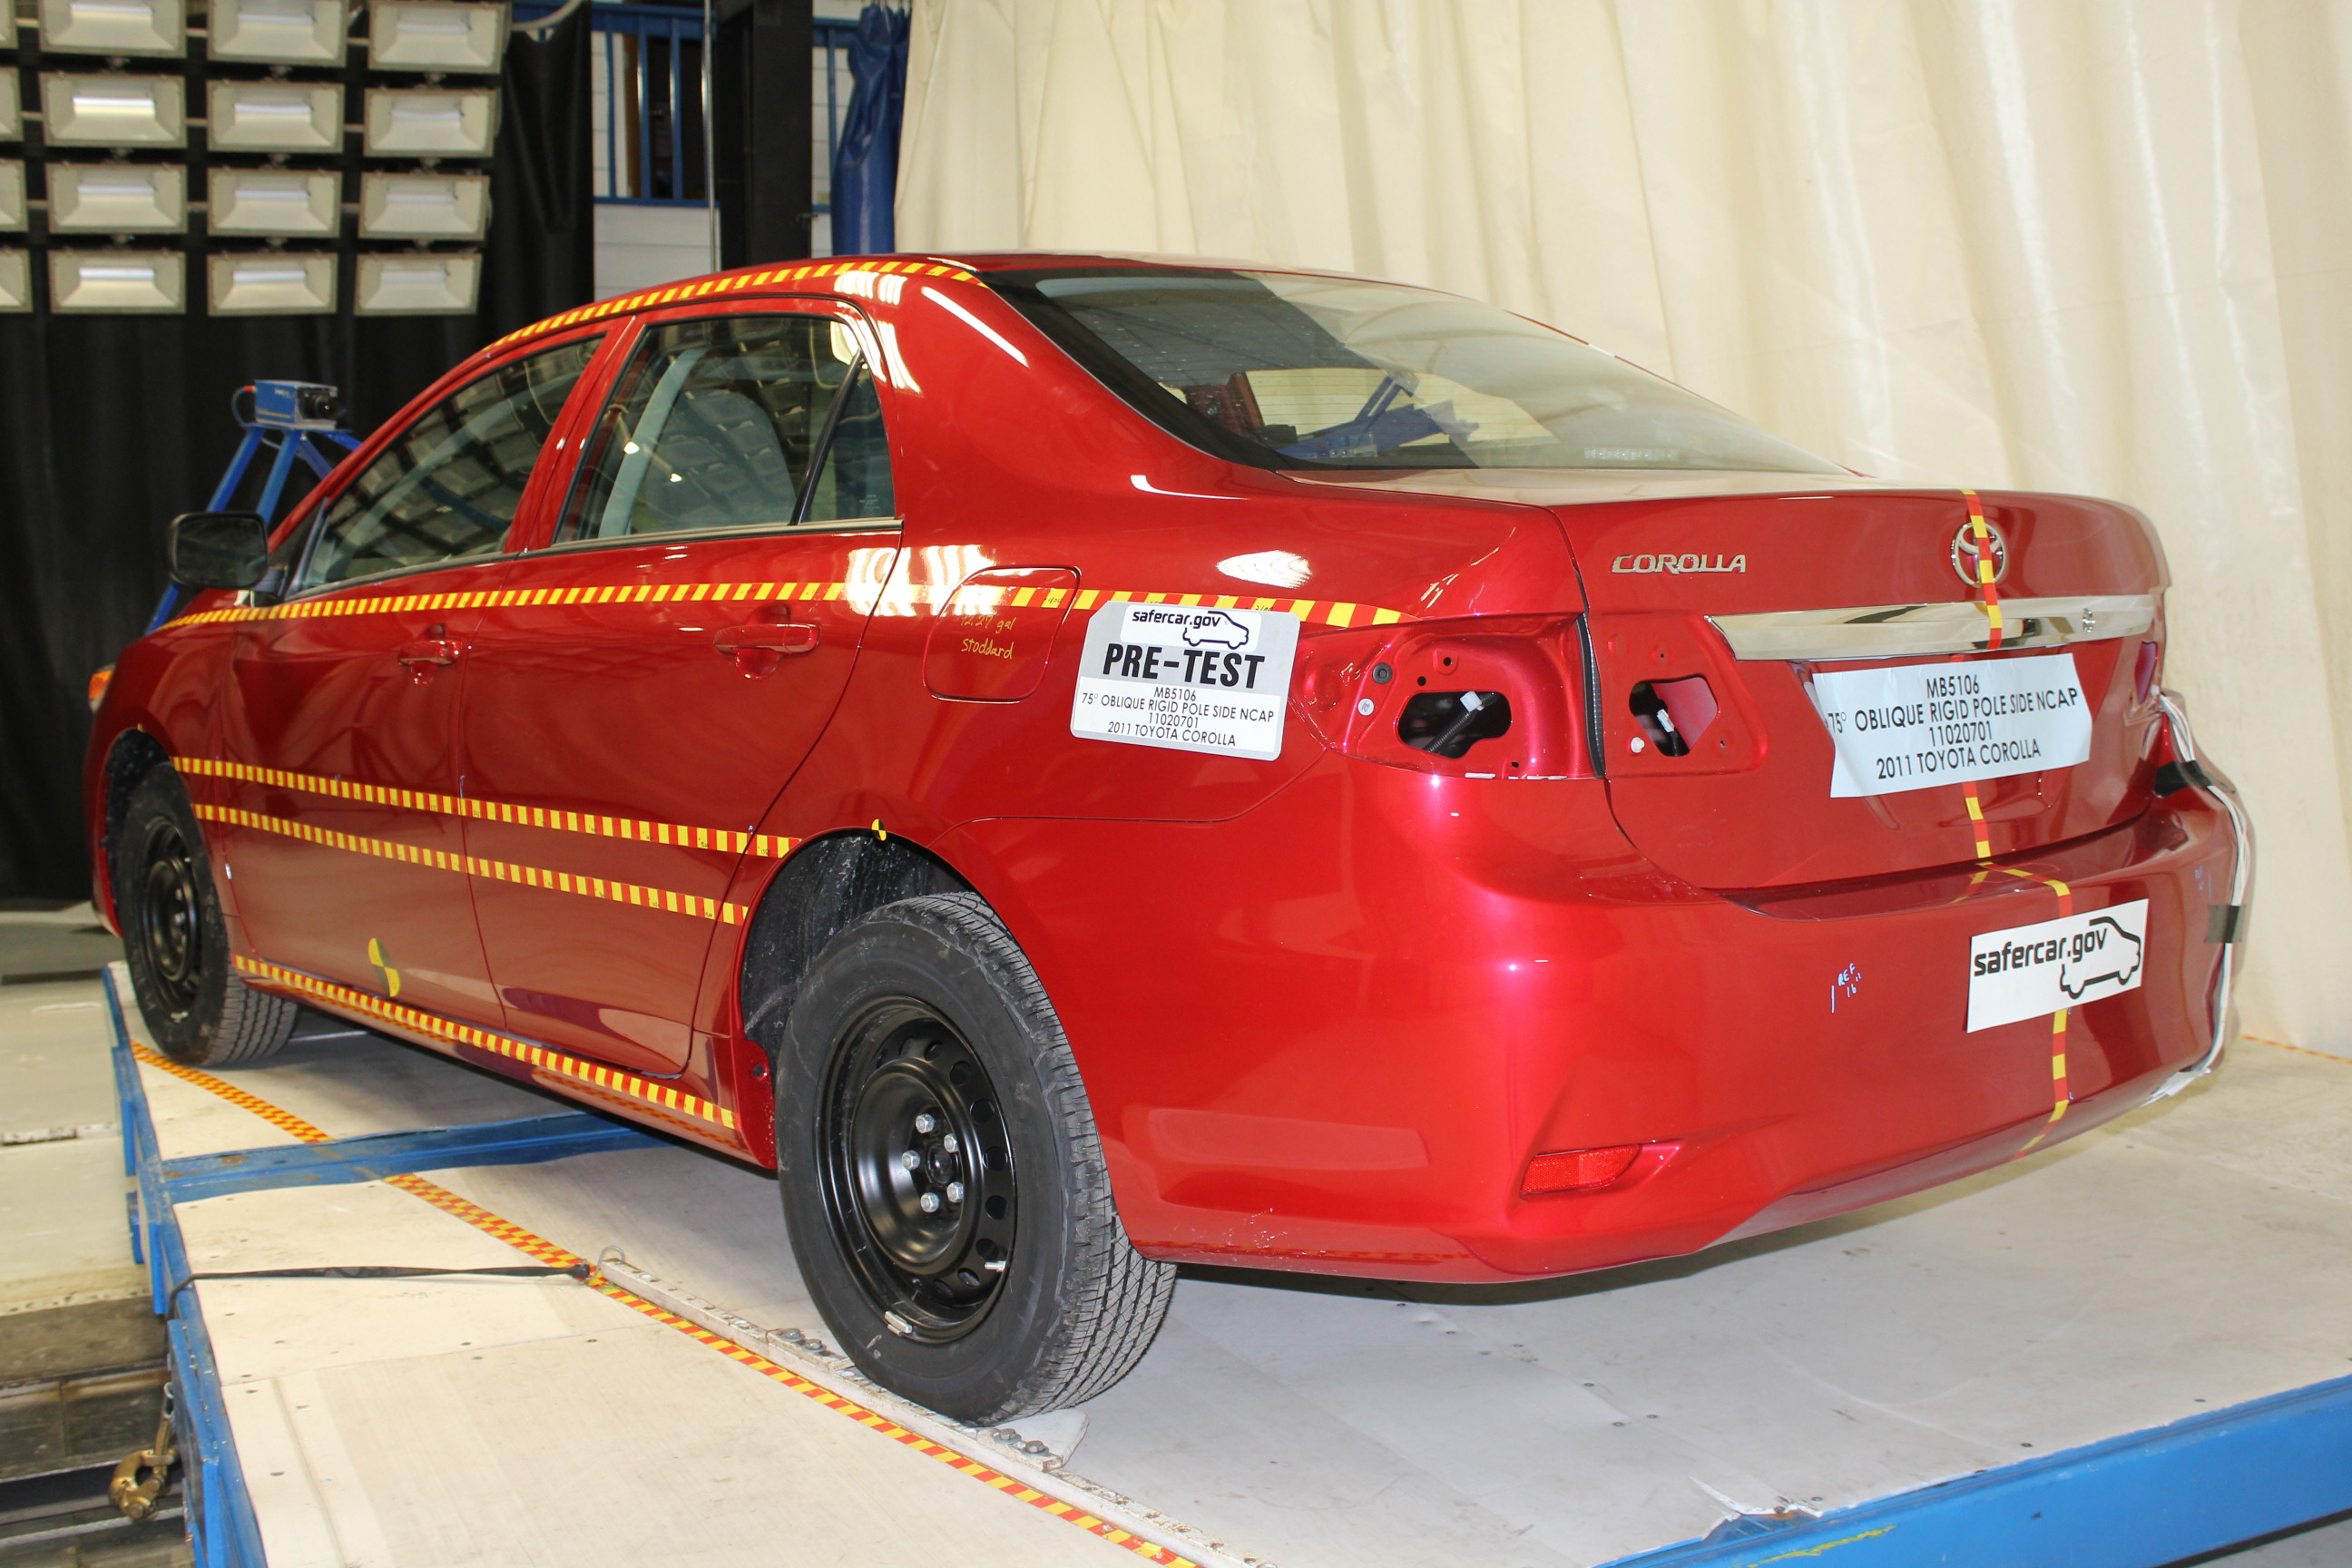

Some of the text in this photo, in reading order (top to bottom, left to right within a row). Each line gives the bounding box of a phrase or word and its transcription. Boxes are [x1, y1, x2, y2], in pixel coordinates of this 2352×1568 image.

[1611, 554, 1747, 575] COROLLA
[996, 617, 1016, 634] gal
[1132, 609, 1221, 629] safercar.gov
[1102, 642, 1266, 690] PRE-TEST
[1153, 687, 1197, 701] MB5106
[1926, 674, 1980, 699] MB5106
[1082, 692, 1275, 723] 75° OBLIQUE RIGID POLE SIDE NCAP
[1854, 703, 1925, 732] OBLIQUE
[1929, 698, 1969, 723] RIGID
[1973, 694, 2007, 719] POLE
[2010, 691, 2034, 714] SIDE
[2037, 688, 2079, 711] NCAP
[1149, 712, 1200, 730] 11020701
[1107, 721, 1236, 747] 2011 TOYOTA COROLLA
[1928, 720, 1993, 748] 11020701
[1876, 738, 2042, 780] 2011 TOYOTA COROLLA
[1973, 927, 2108, 977] safercar.gov
[1838, 962, 1857, 987] REF
